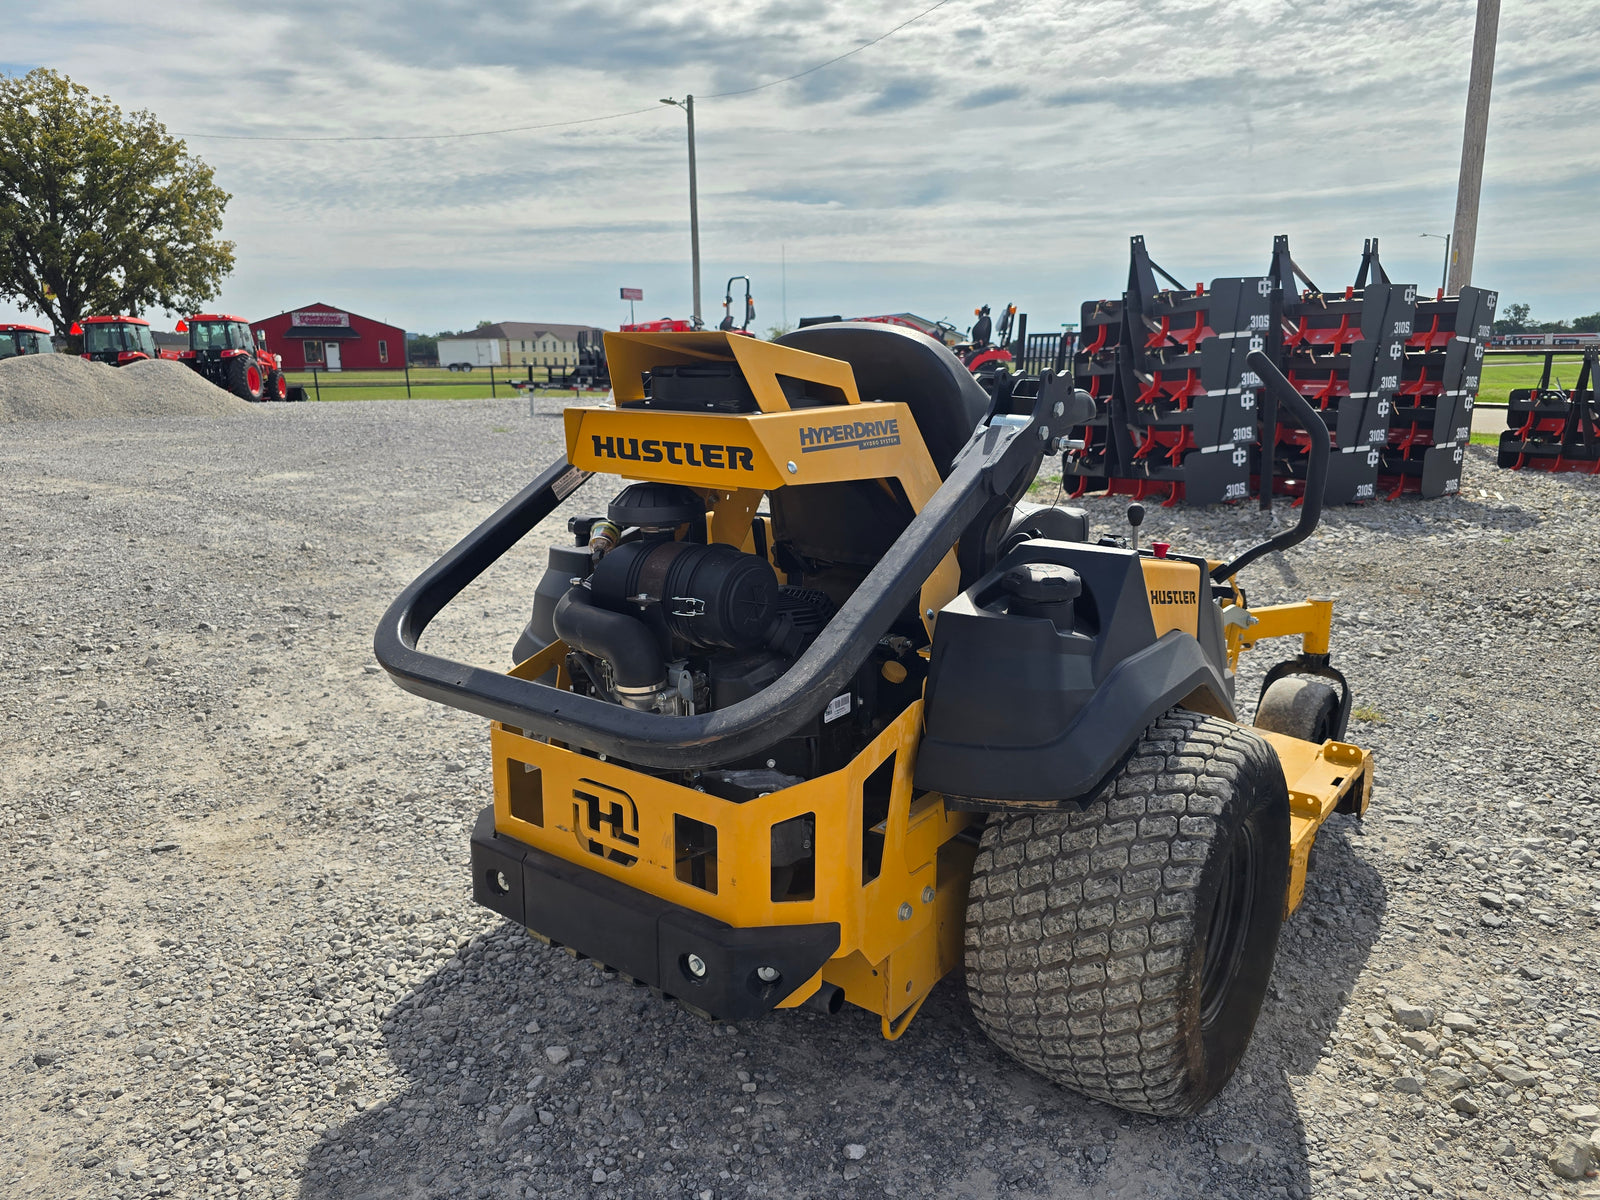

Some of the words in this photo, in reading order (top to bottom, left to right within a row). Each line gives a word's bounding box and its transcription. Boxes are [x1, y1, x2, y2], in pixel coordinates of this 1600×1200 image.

[1250, 314, 1270, 328] 310S
[1393, 321, 1411, 334] 310S
[1478, 325, 1490, 337] 310S
[1380, 376, 1397, 388] 310S
[1233, 426, 1252, 440] 310S
[1368, 429, 1385, 442] 310S
[591, 435, 754, 471] HUSTLER
[1226, 482, 1245, 496] 310S
[1356, 484, 1373, 496] 310S
[1150, 590, 1196, 604] HUSTLER
